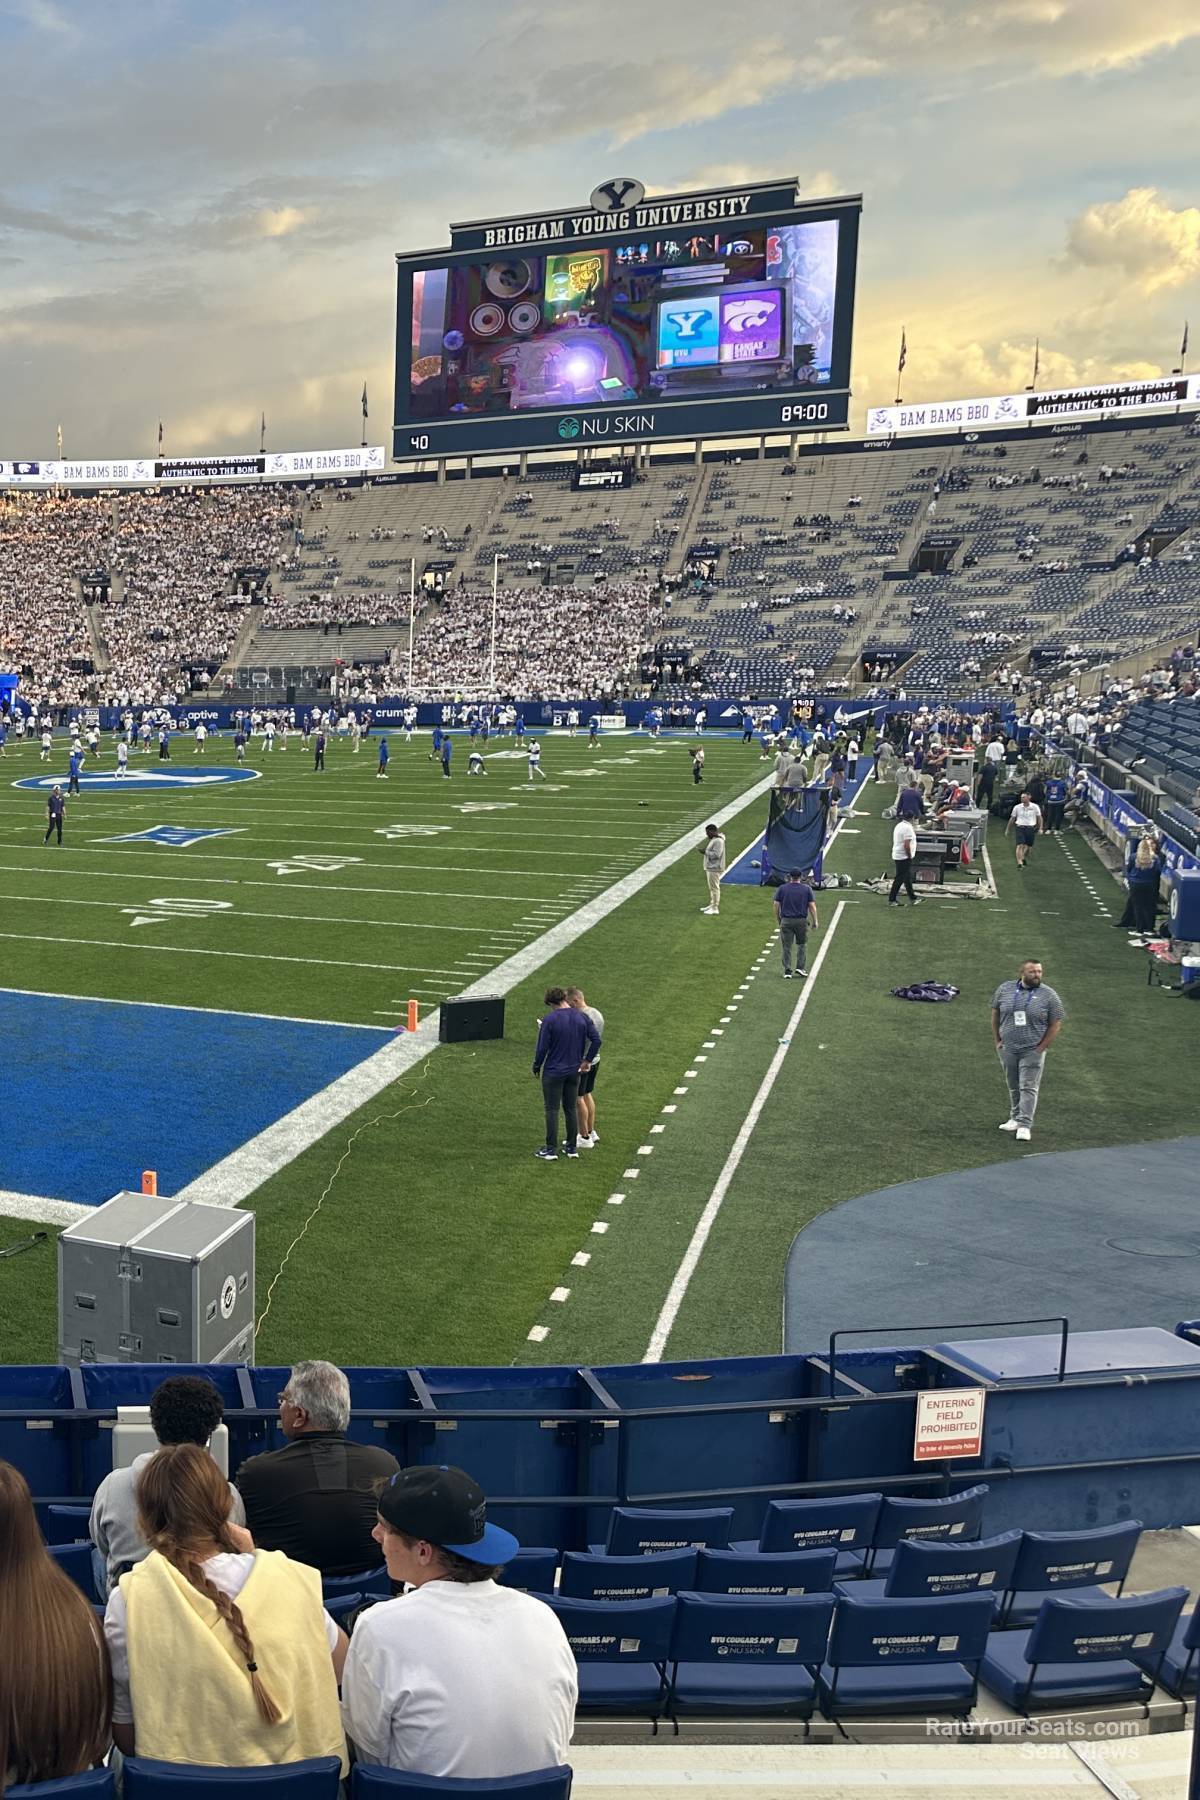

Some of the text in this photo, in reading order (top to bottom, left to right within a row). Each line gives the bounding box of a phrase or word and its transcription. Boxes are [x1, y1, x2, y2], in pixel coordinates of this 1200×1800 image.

[485, 196, 751, 246] BRIGHAM YOUNG UNIVERSITY
[734, 341, 764, 351] KANSAS
[734, 350, 756, 358] STATE
[1036, 391, 1178, 415] AUTHENTIC TO THE BONE
[781, 403, 828, 422] 89:00
[900, 411, 925, 426] BAM
[930, 408, 962, 423] BAMS
[582, 416, 654, 435] NU SKIN
[411, 435, 429, 450] 40
[863, 440, 891, 449] smarty
[293, 458, 313, 470] BAM
[316, 456, 342, 468] BAMS
[63, 466, 84, 480] BAM
[87, 465, 112, 480] BAMS
[161, 465, 259, 477] AUTHENTIC TO THE BONE
[578, 471, 624, 486] ESPN
[187, 710, 219, 722] aptive
[376, 708, 404, 718] crum
[266, 854, 364, 872] 20
[926, 1398, 975, 1409] ENTERING
[936, 1411, 963, 1420] FIELD
[921, 1422, 977, 1433] PROHIBITED
[711, 1636, 724, 1644] BYU
[725, 1636, 758, 1644] COUGARS
[872, 1635, 936, 1644] BYU COUGARS APP
